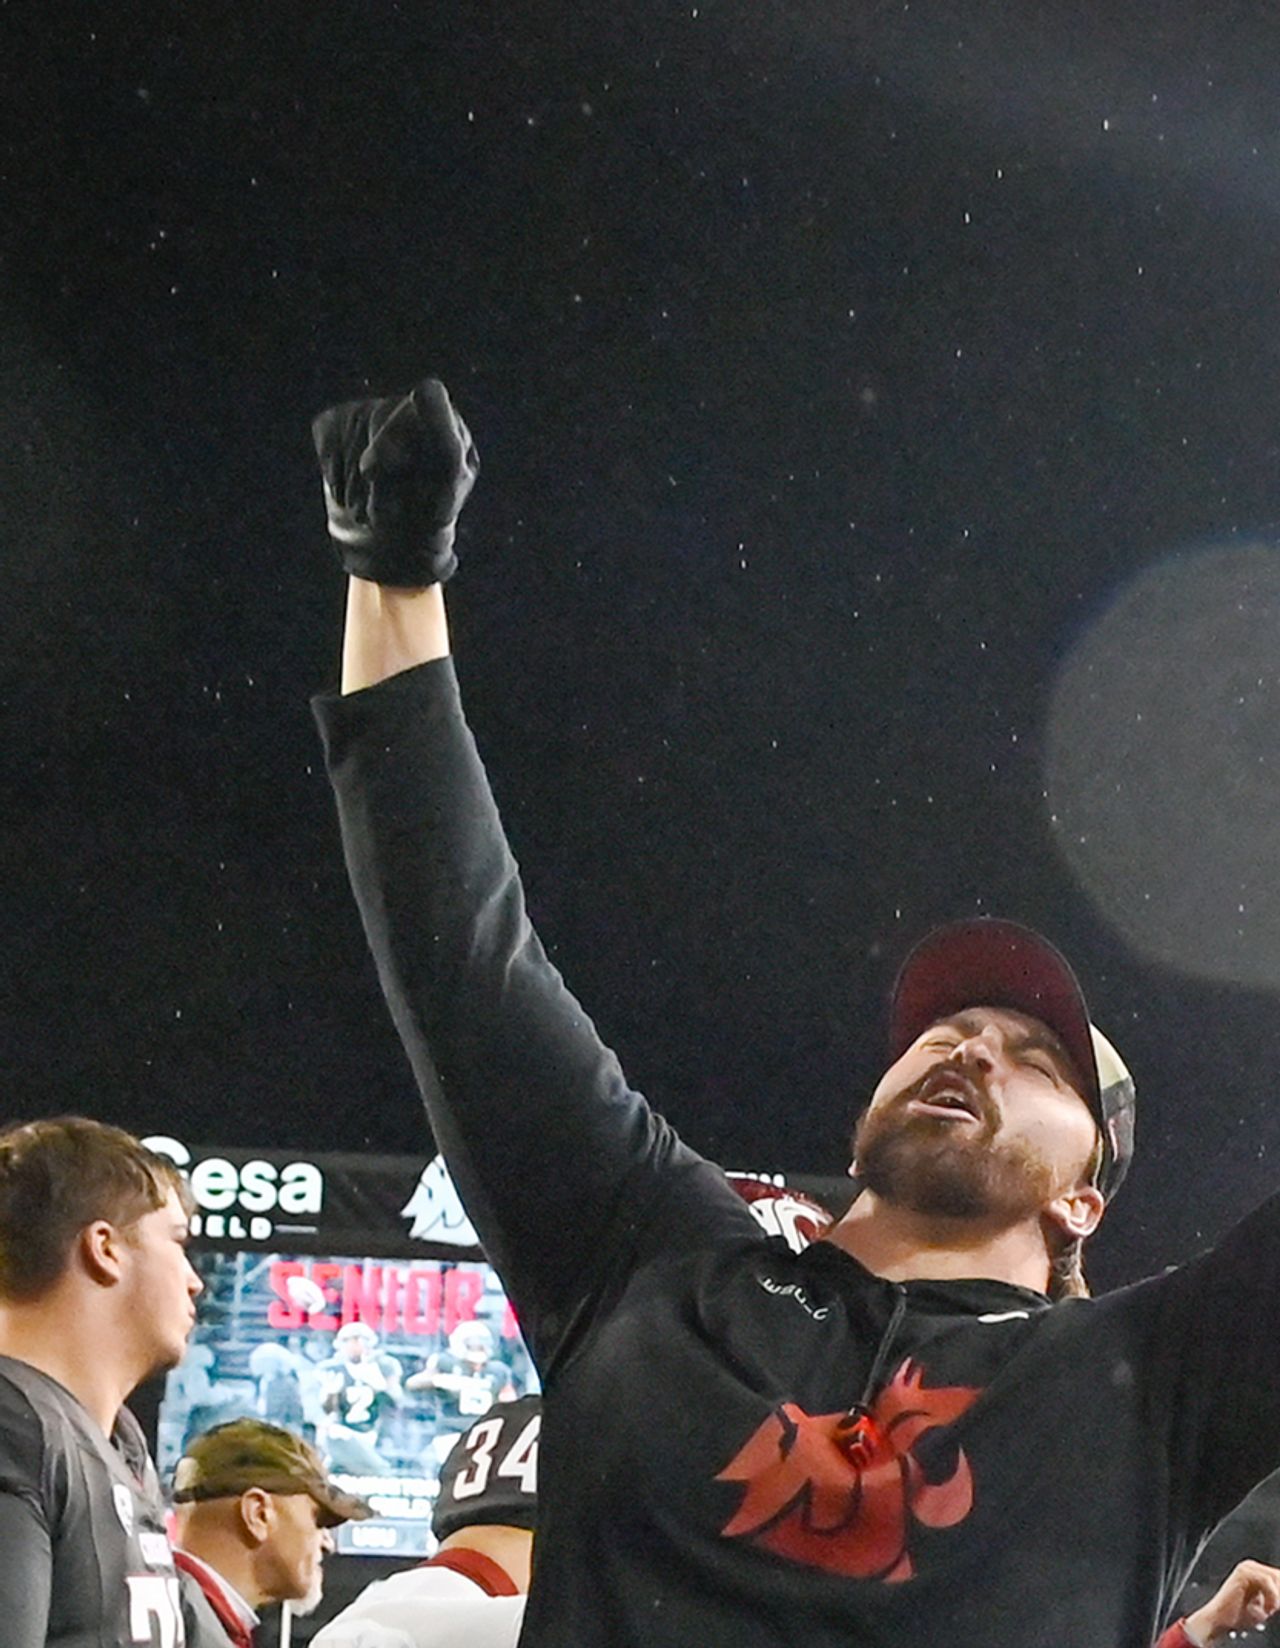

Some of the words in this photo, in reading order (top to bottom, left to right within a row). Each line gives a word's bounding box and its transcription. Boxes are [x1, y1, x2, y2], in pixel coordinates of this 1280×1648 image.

[190, 1215, 273, 1240] IELD
[268, 1261, 483, 1336] SENIOR
[453, 1414, 542, 1500] 34
